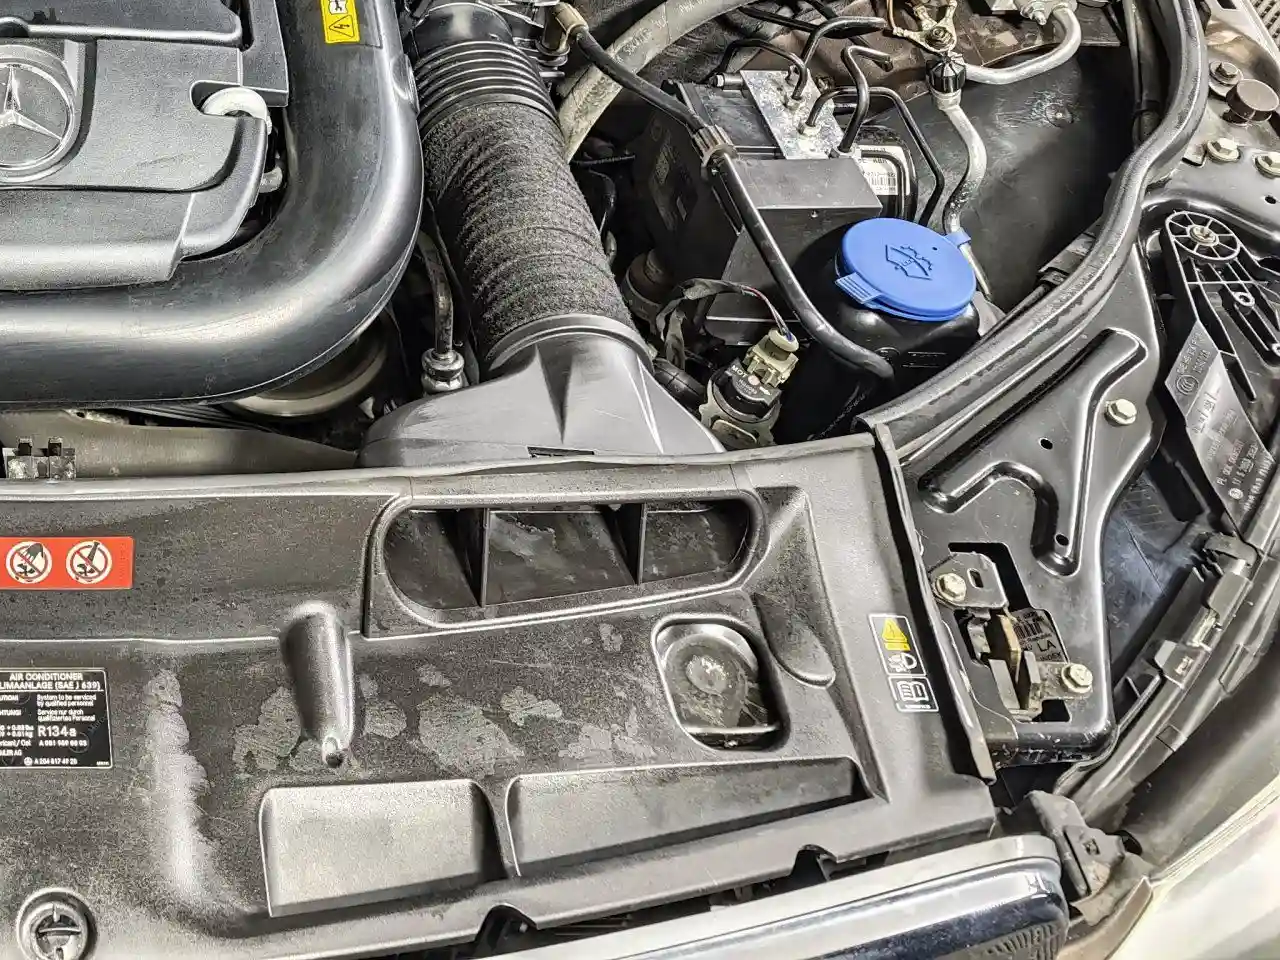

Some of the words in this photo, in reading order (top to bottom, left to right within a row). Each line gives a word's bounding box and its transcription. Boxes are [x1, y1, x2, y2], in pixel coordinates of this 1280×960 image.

[9, 673, 24, 681] AIR
[25, 672, 84, 681] CONDITIONER
[81, 681, 101, 690] 639)
[37, 725, 77, 737] R134a
